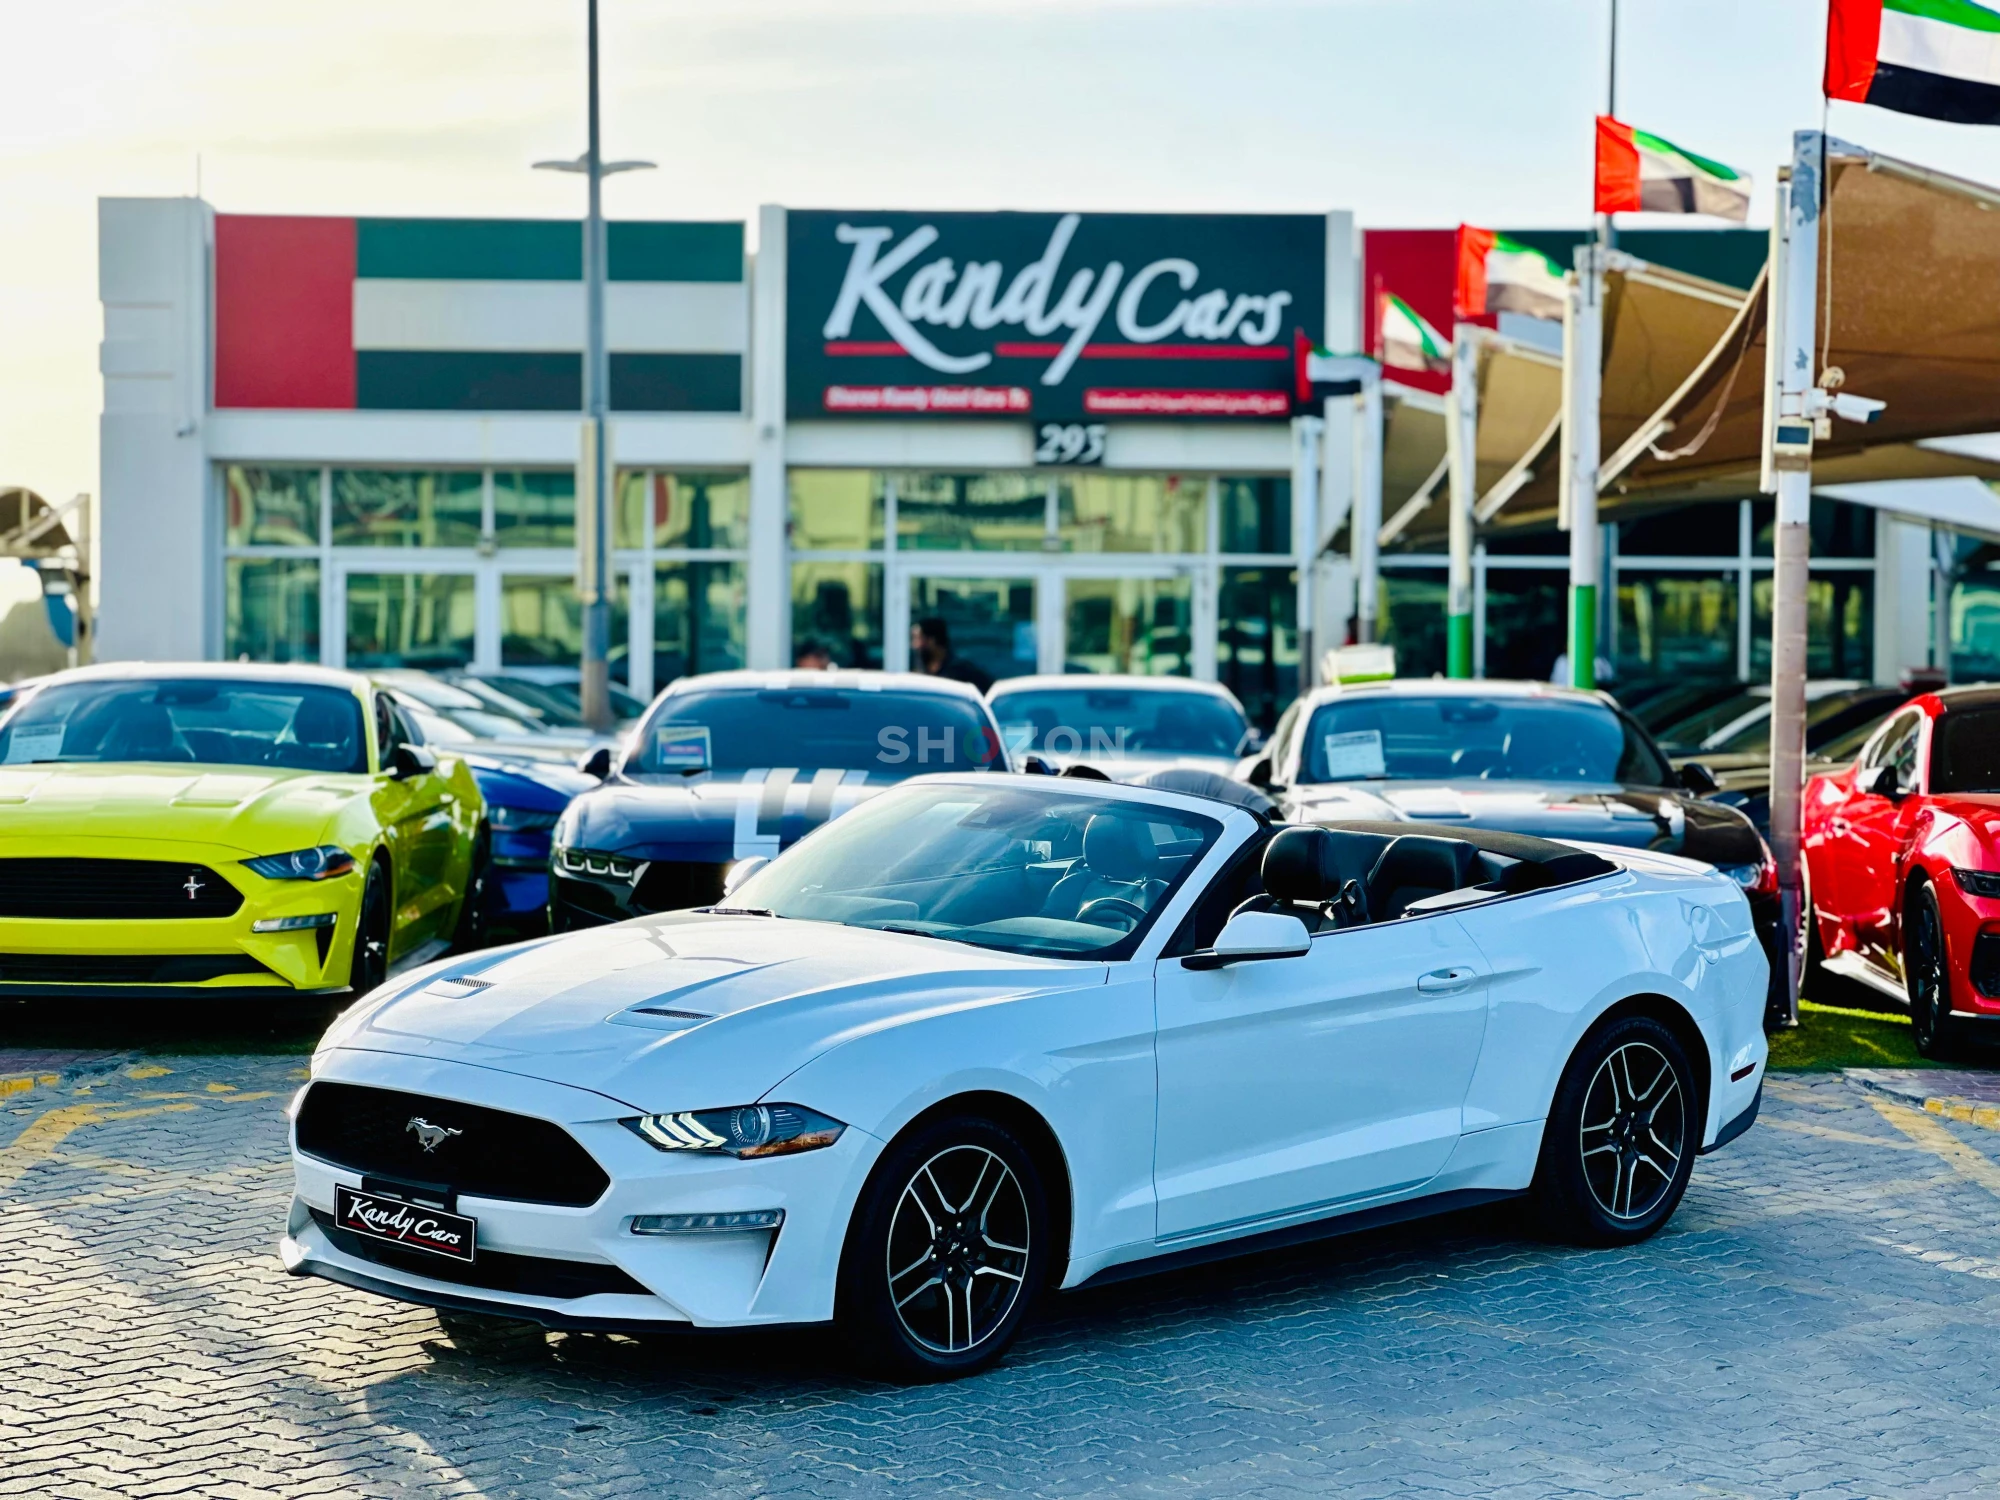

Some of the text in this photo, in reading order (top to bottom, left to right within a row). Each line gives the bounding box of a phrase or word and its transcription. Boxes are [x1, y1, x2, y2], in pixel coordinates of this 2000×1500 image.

[824, 213, 1292, 385] Kandy Cars
[1034, 423, 1107, 463] 295
[347, 1195, 462, 1245] Kandy Cars
